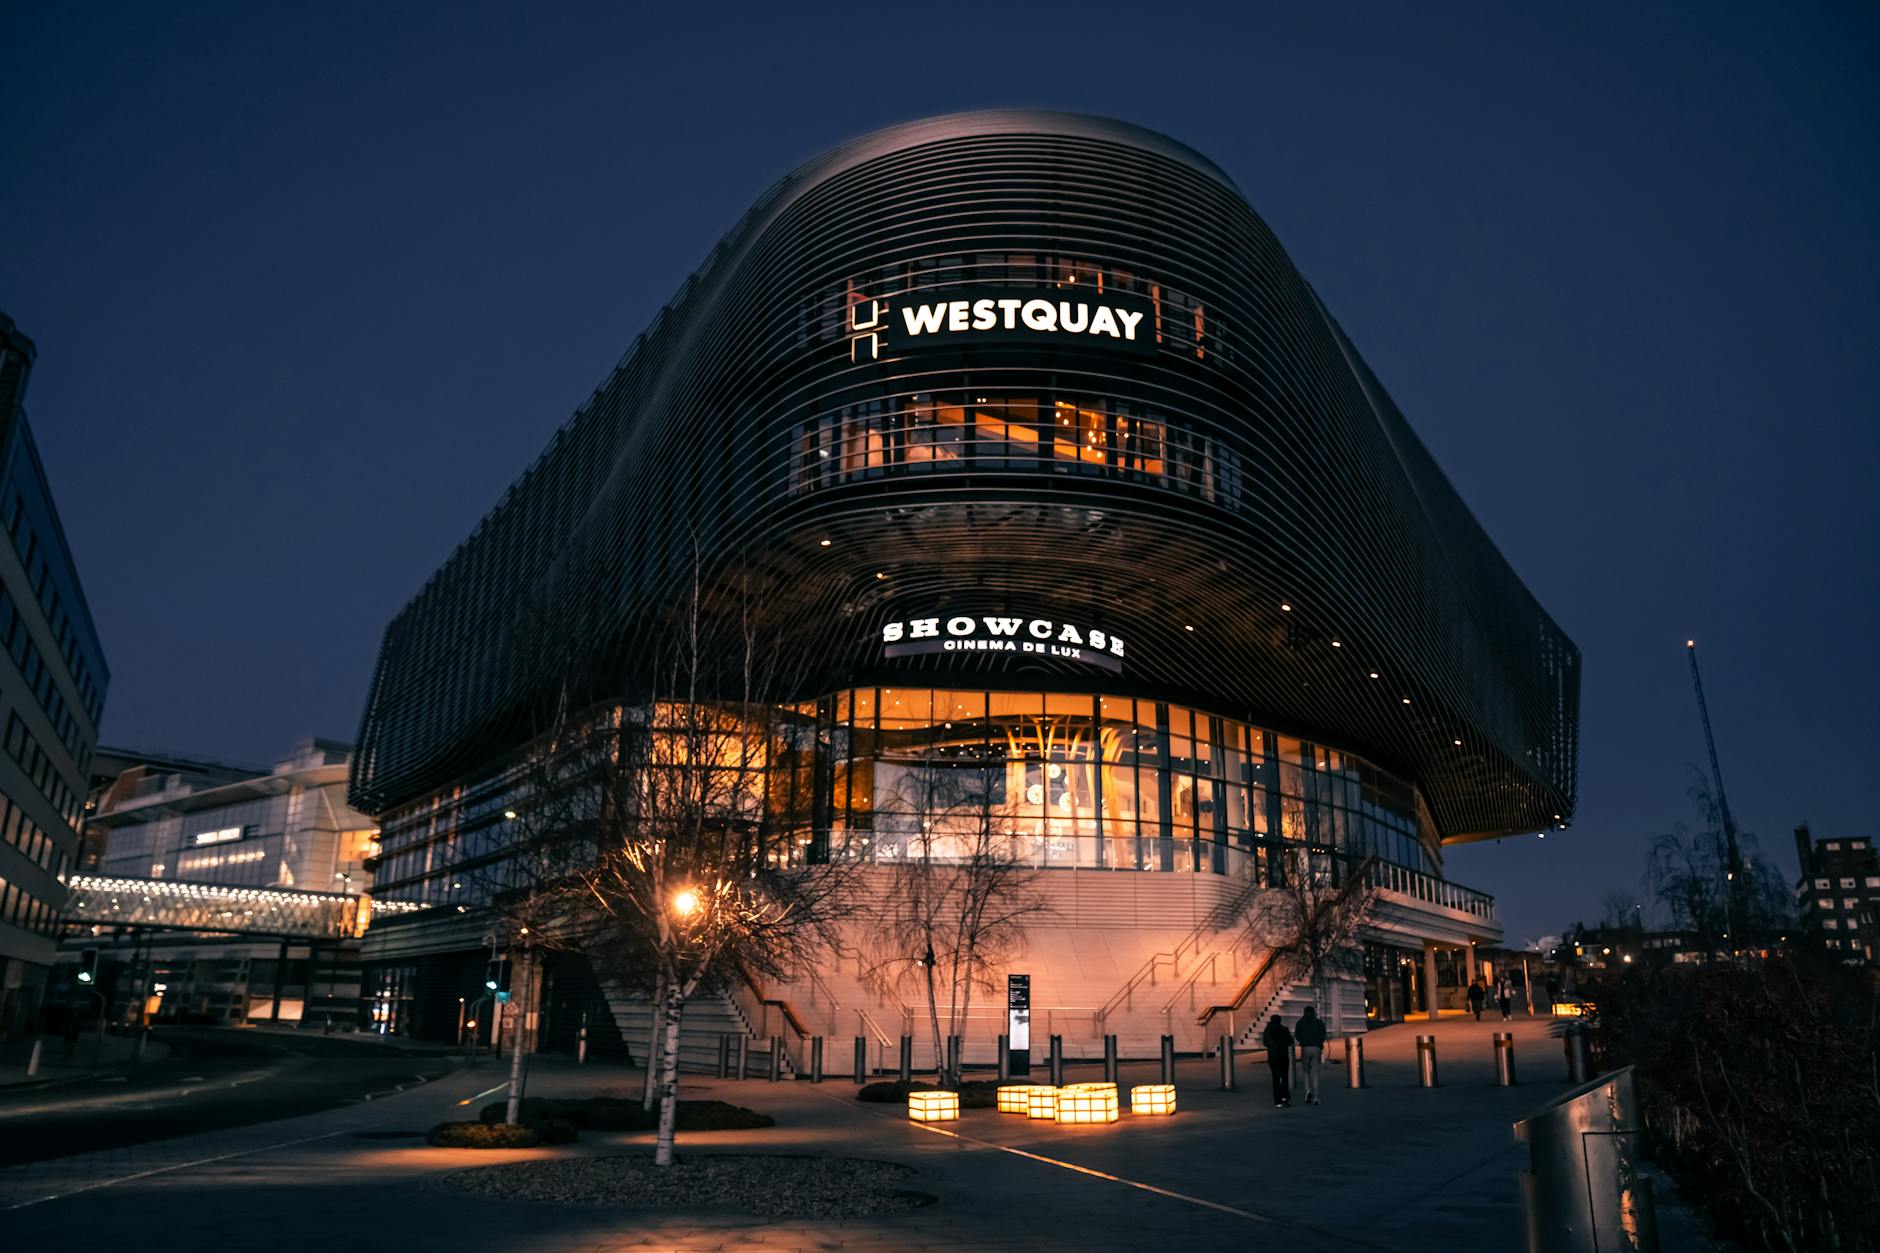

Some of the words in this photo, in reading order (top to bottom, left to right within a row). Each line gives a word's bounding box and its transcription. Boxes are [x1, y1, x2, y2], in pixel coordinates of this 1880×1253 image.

[901, 298, 1144, 341] WESTQUAY
[882, 616, 1125, 658] SHOWCASE
[943, 639, 1017, 651] CINEMA
[1022, 641, 1046, 654] DE
[1050, 644, 1081, 659] LUX
